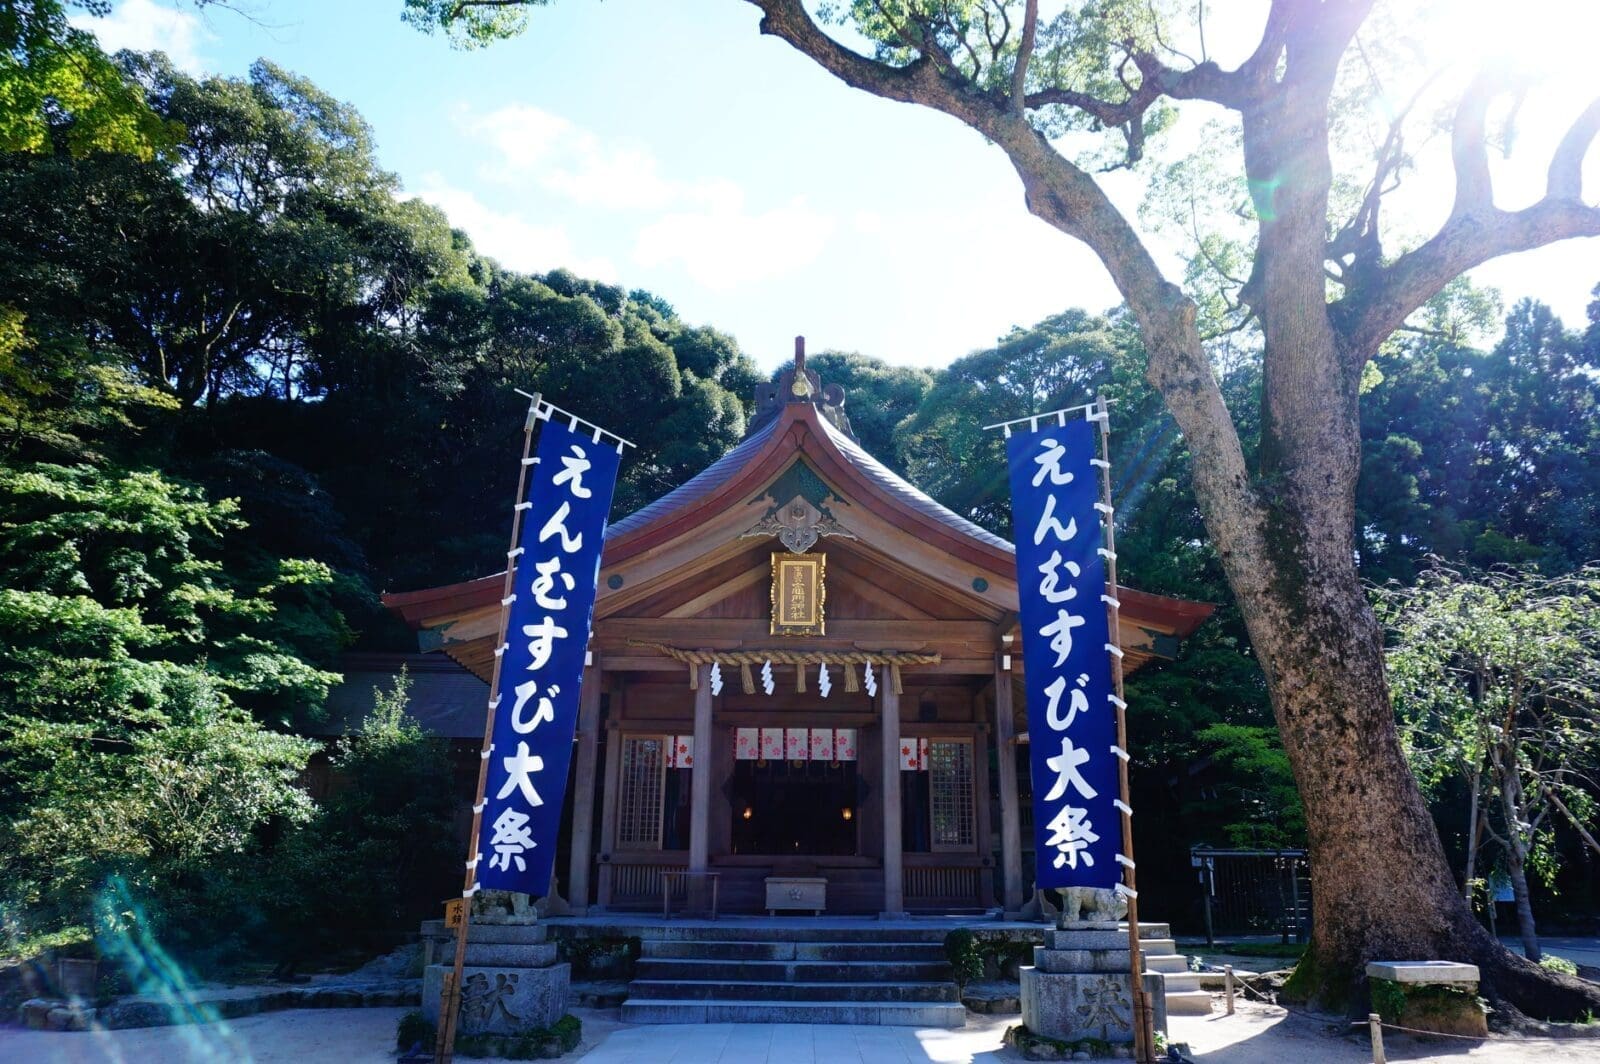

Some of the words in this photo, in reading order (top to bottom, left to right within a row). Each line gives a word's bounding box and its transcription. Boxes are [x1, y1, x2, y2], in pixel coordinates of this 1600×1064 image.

[489, 445, 593, 872] えんむすび大祭
[1032, 438, 1101, 870] えんむすび大祭
